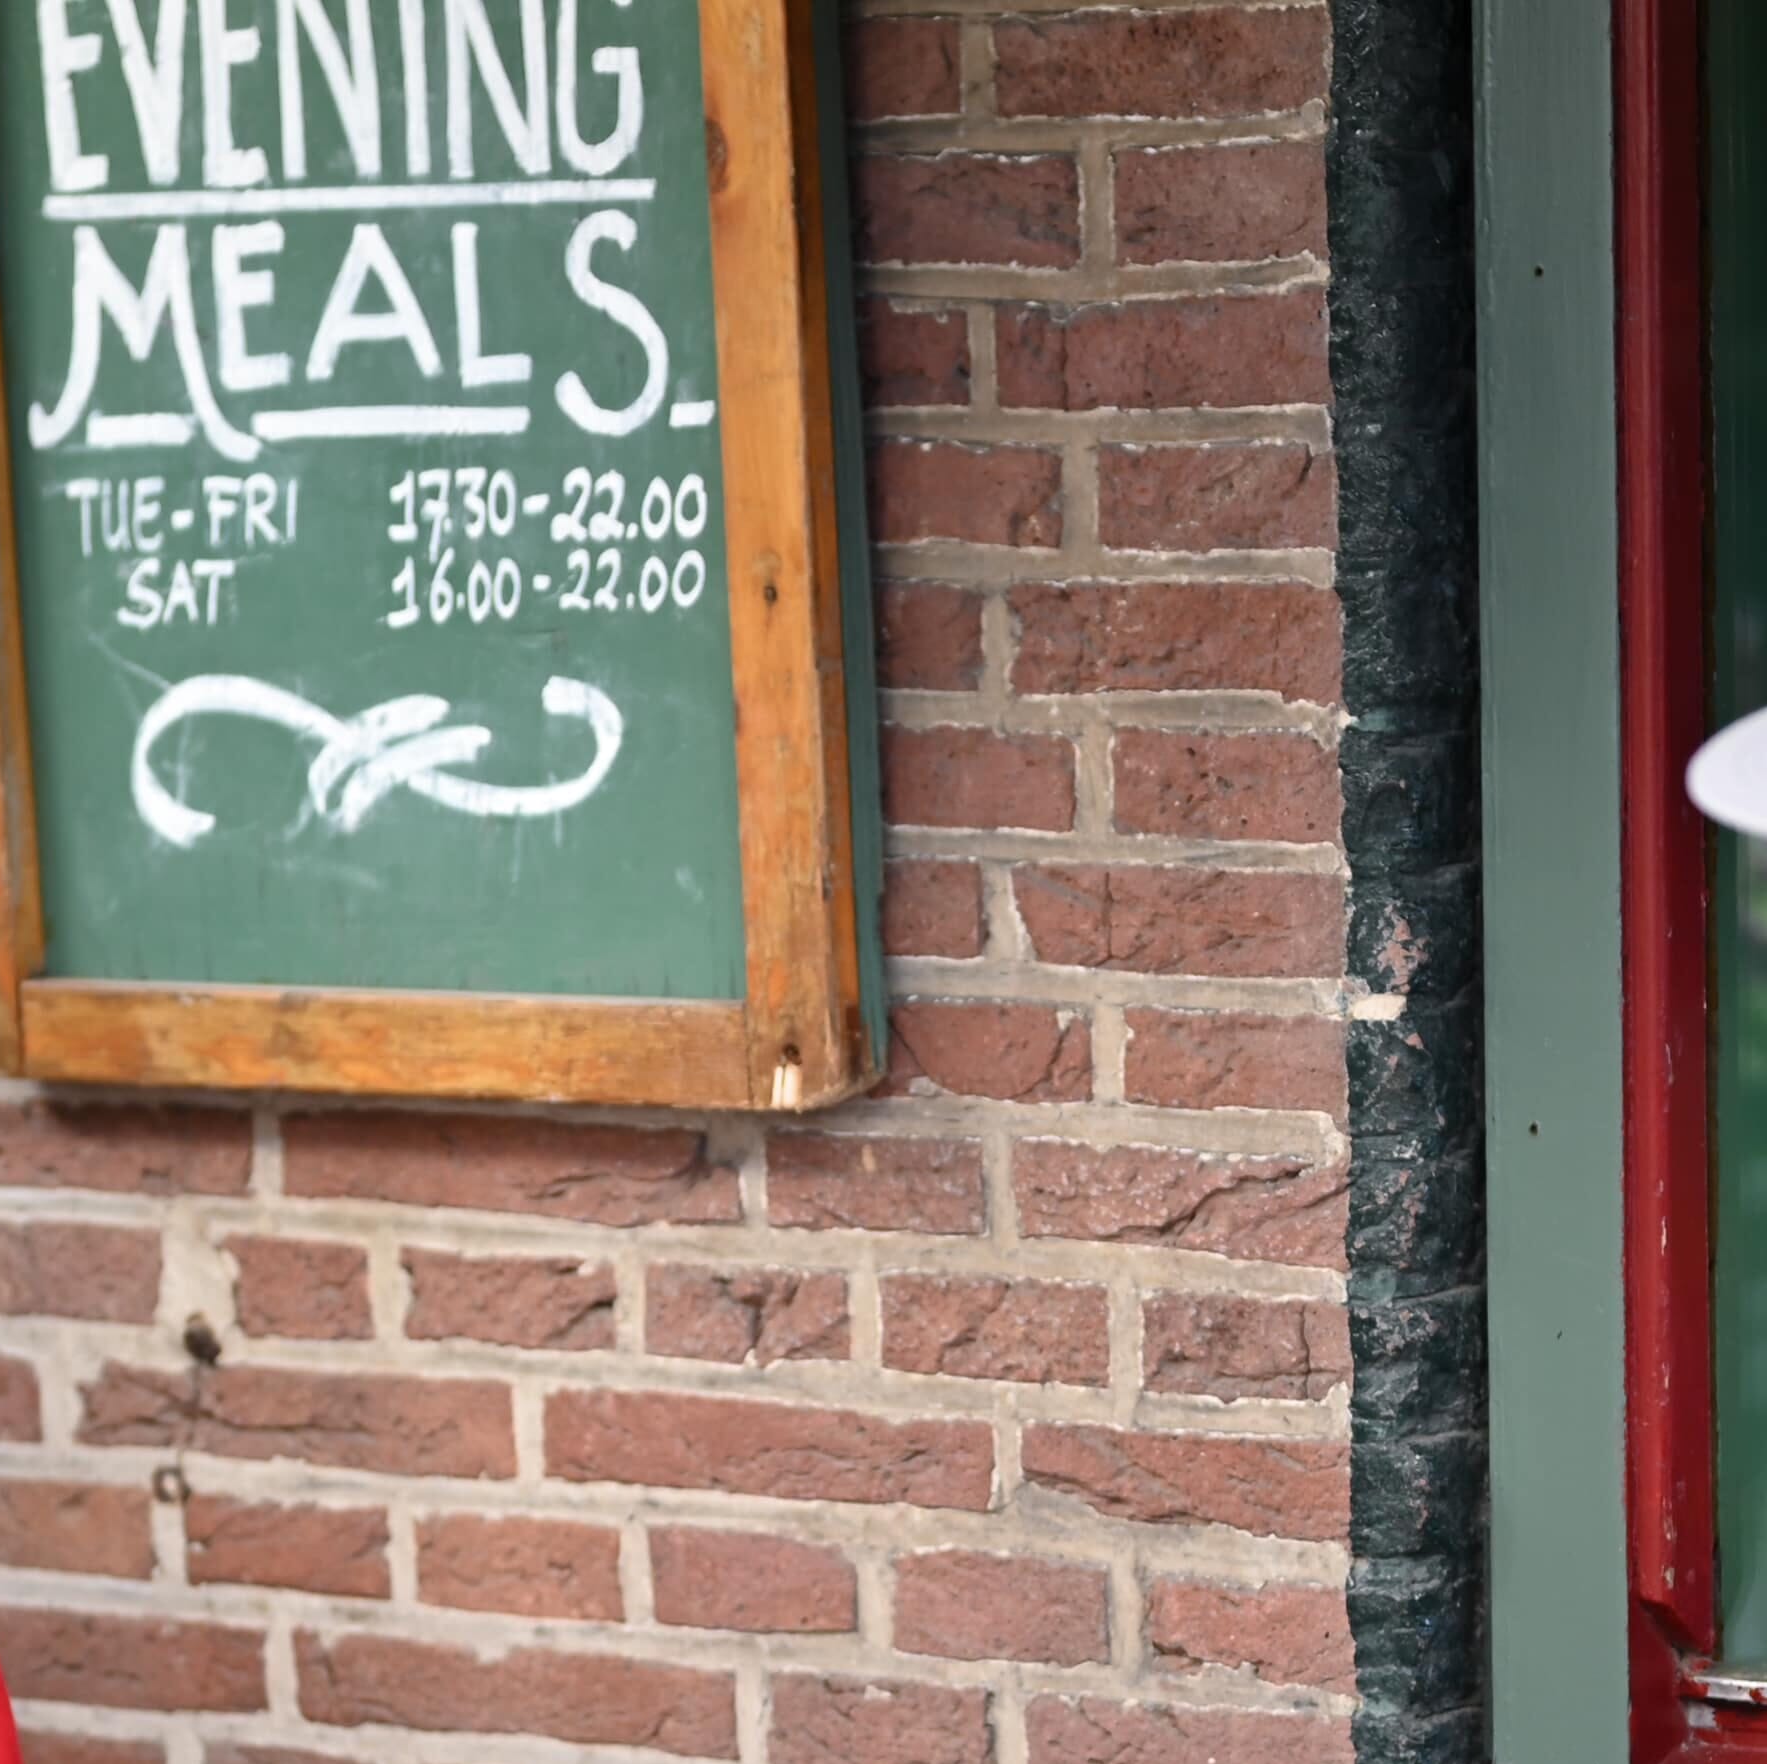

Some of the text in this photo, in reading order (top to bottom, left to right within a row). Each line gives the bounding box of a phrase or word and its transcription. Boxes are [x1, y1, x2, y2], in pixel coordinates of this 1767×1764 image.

[36, 0, 643, 190] EVENING
[28, 209, 672, 461] MEALS
[116, 557, 236, 629] SAT
